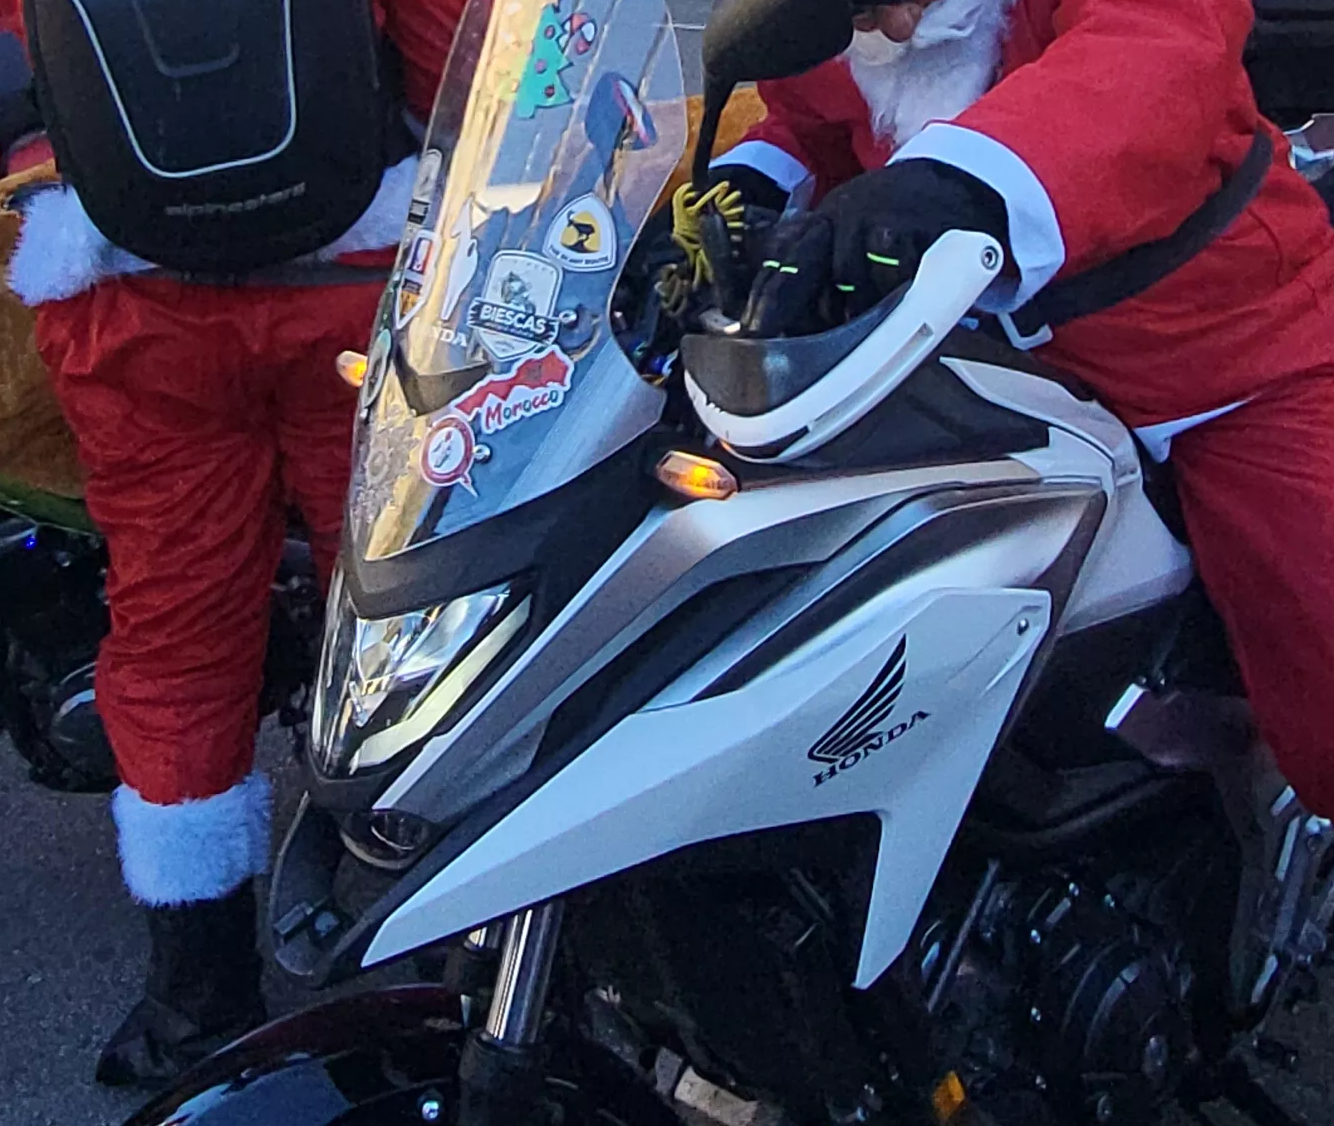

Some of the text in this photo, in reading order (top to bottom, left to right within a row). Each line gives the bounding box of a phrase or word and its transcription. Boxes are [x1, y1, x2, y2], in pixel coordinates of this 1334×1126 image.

[480, 305, 547, 334] BIESCAS
[485, 390, 559, 429] Morocco
[812, 710, 932, 788] HONDA
